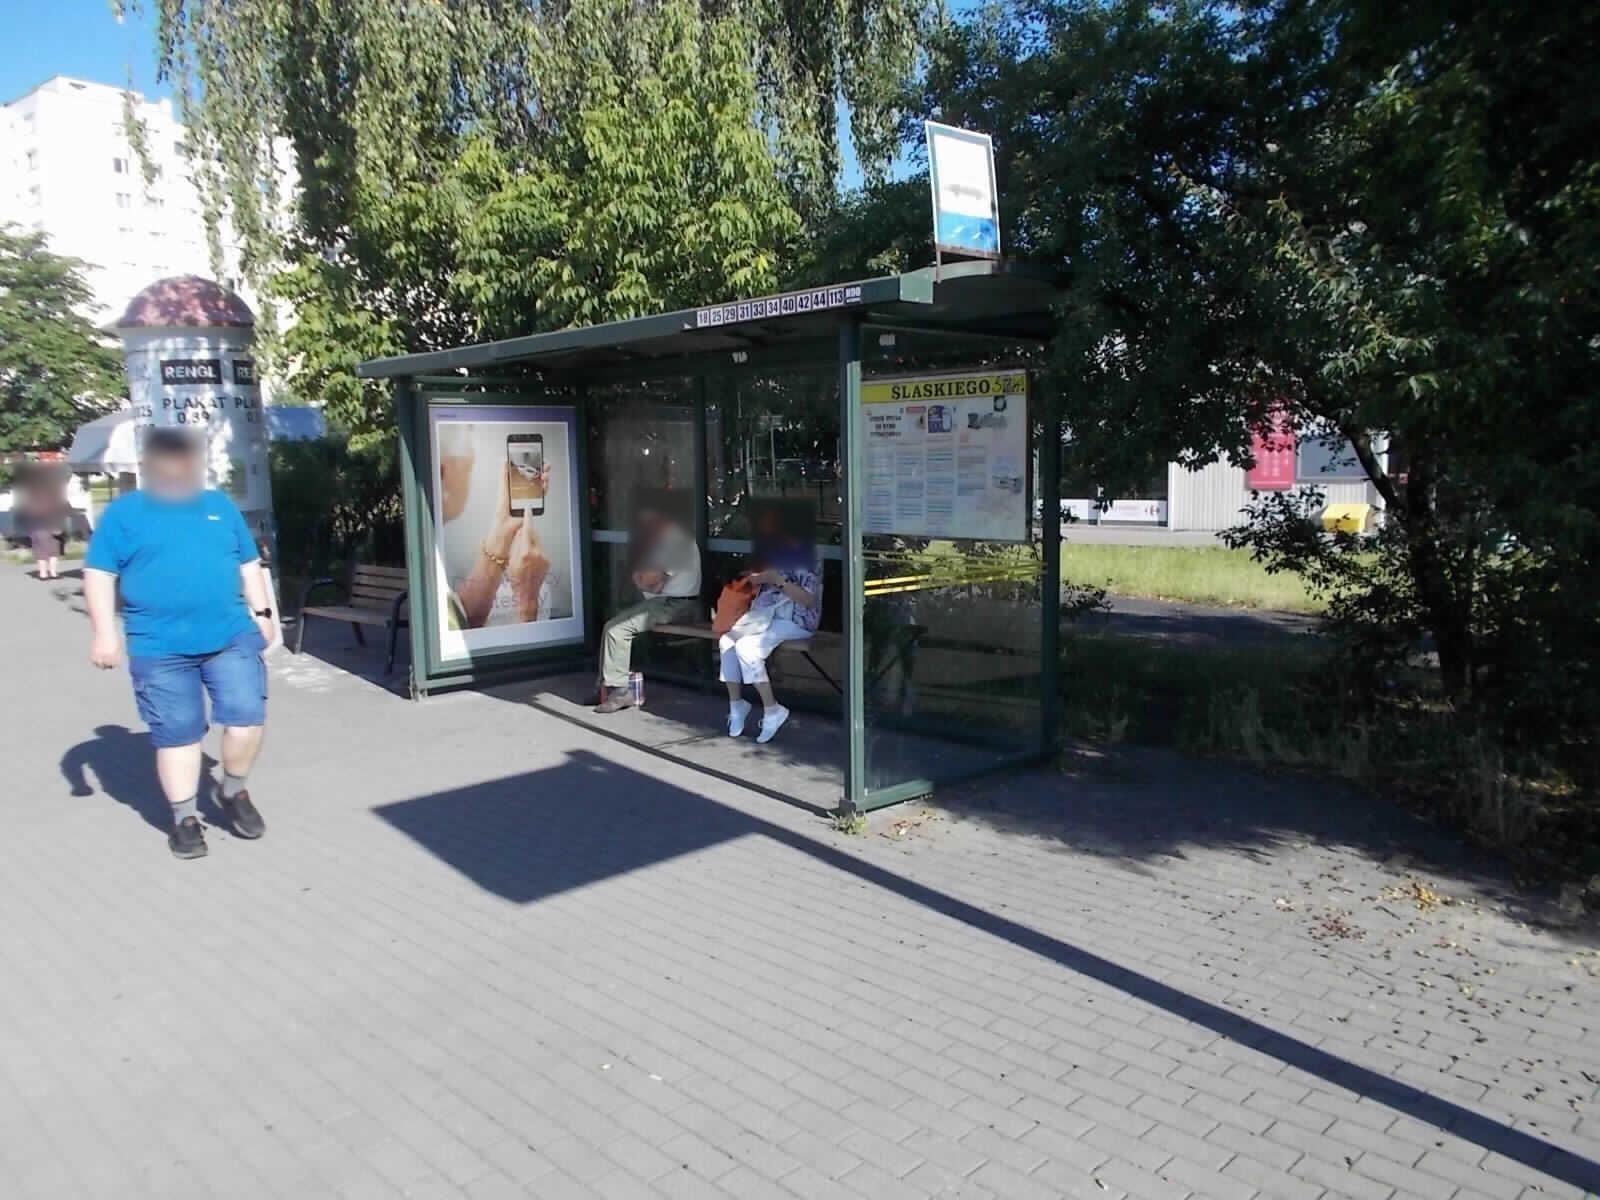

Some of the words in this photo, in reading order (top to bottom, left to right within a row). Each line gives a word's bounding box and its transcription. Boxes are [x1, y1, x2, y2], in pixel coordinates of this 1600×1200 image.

[712, 310, 722, 322] 25
[725, 308, 736, 320] 29
[739, 305, 750, 319] 31
[753, 303, 764, 317] 33
[768, 300, 778, 314] 34
[782, 298, 794, 312] 40
[798, 295, 809, 309] 42
[813, 293, 825, 306] 44
[830, 290, 843, 304] 113
[164, 366, 217, 379] RENGL
[163, 397, 226, 410] PLAKAT
